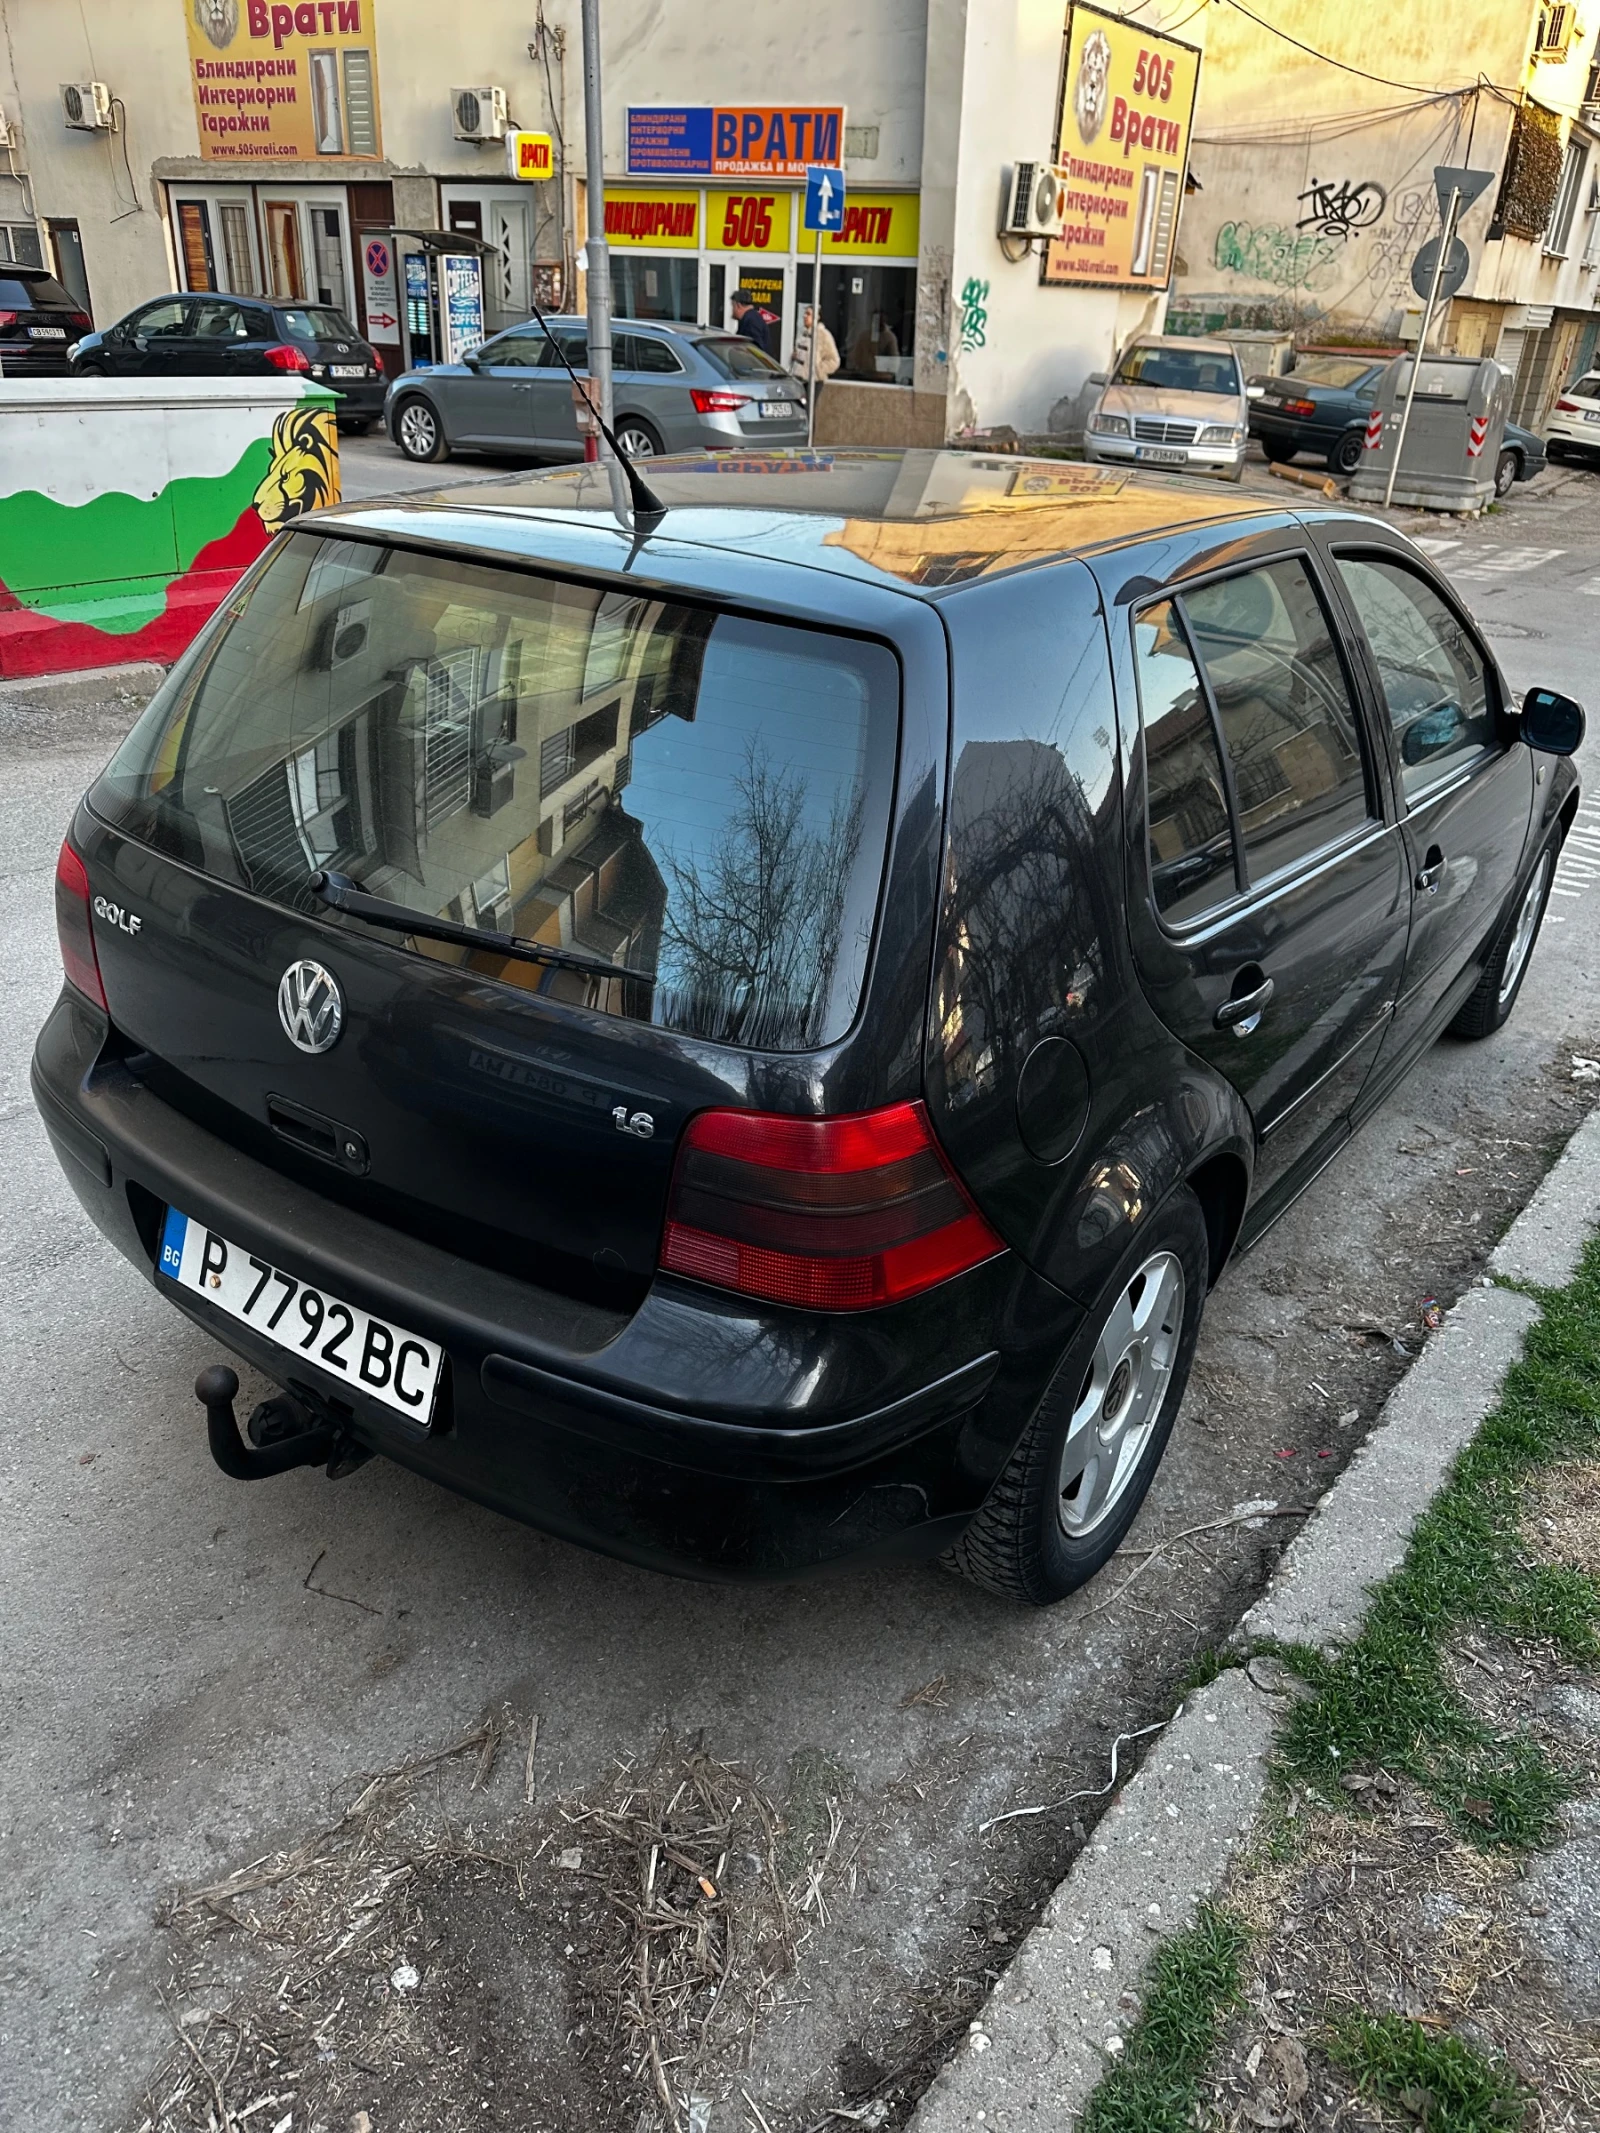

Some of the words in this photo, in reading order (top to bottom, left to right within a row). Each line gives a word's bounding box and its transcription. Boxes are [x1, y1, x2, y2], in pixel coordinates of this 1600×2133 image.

[247, 0, 361, 49] Врати
[195, 59, 297, 82] Блиндирани
[1133, 48, 1176, 103] 505
[198, 85, 297, 109] Интериорни
[201, 111, 271, 137] Гаражни
[716, 113, 839, 160] ВРАТИ
[1109, 96, 1181, 158] Врати
[210, 142, 298, 156] www.505vrati.com
[521, 143, 549, 168] ВРАТИ
[715, 160, 773, 173] ПРОДАЖБА
[776, 161, 785, 172] И
[1061, 150, 1134, 192] Блиндирани
[604, 201, 696, 240] ЛИНДИРАНИ
[722, 196, 775, 248] 505
[1066, 190, 1129, 223] нтериорни
[1058, 221, 1106, 250] аражни
[449, 313, 481, 325] COFFEE
[94, 896, 143, 935] GOLF
[163, 1245, 181, 1268] BG
[199, 1230, 228, 1288] P
